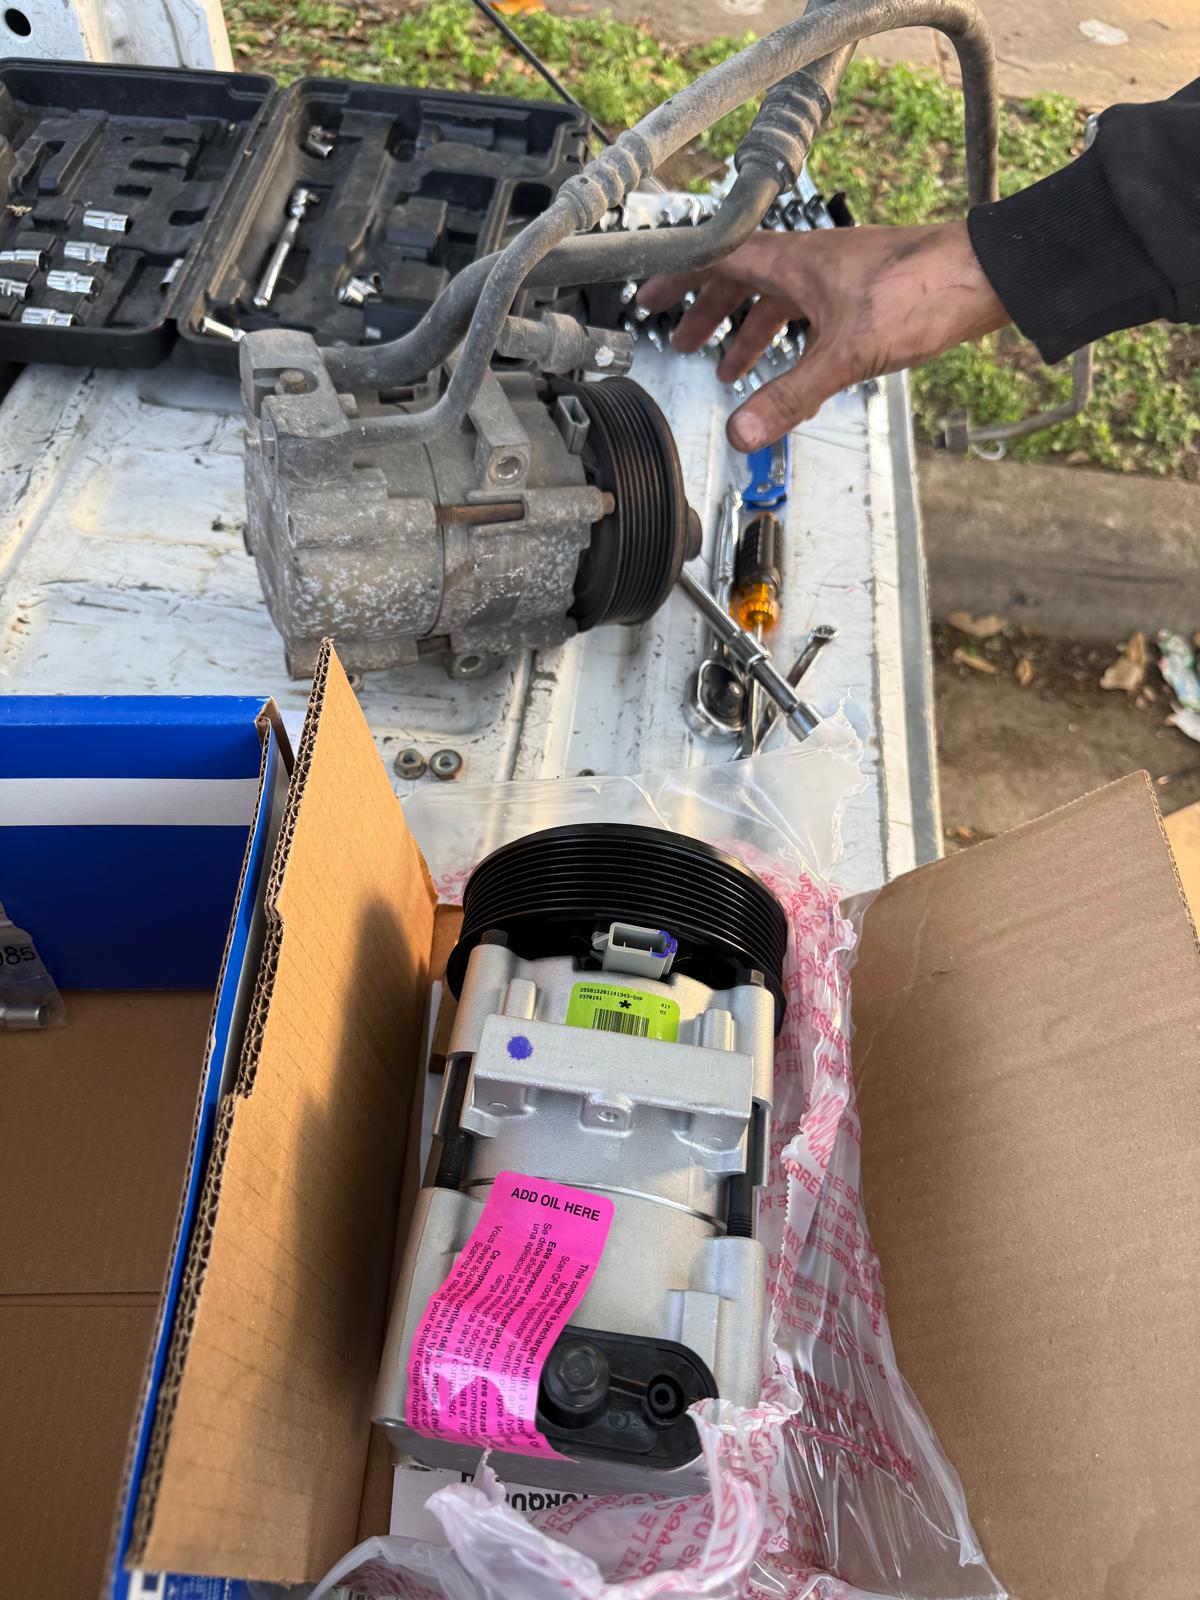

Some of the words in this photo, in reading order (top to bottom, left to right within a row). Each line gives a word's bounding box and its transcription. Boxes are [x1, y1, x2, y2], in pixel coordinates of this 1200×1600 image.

[511, 1187, 538, 1203] ADD
[540, 1194, 561, 1210] OIL
[563, 1201, 601, 1221] HERE
[487, 1226, 502, 1243] Vous
[529, 1223, 539, 1239] una
[542, 1222, 552, 1235] Se
[460, 1241, 482, 1270] Scannez
[475, 1244, 491, 1264] devez
[489, 1249, 500, 1260] Ce
[533, 1237, 546, 1256] debe
[542, 1241, 556, 1259] Este
[512, 1241, 533, 1273] aplicación
[522, 1257, 537, 1276] añadir
[554, 1255, 569, 1272] Scan
[462, 1265, 479, 1288] ajouter
[517, 1276, 526, 1284] la
[522, 1260, 546, 1295] compresor
[548, 1273, 560, 1284] QR
[575, 1265, 588, 1278] This
[489, 1274, 504, 1292] carga
[500, 1274, 515, 1295] puede
[539, 1284, 552, 1300] code
[553, 1282, 567, 1297] Must
[554, 1280, 578, 1315] compressor
[428, 1301, 440, 1321] pour
[443, 1299, 465, 1334] contient
[490, 1310, 503, 1323] tipo
[434, 1320, 443, 1329] et
[476, 1319, 484, 1328] el
[484, 1325, 494, 1336] de
[489, 1307, 516, 1350] precargado
[416, 1323, 431, 1357] obtenir
[431, 1330, 440, 1339] le
[458, 1324, 471, 1344] para
[525, 1321, 552, 1364] precharged
[424, 1341, 436, 1364] type
[454, 1346, 461, 1356] el
[463, 1329, 480, 1359] código
[472, 1337, 487, 1366] aceite
[433, 1361, 441, 1369] 3
[482, 1351, 493, 1372] con
[500, 1340, 516, 1375] specific
[412, 1360, 421, 1385] cette
[460, 1362, 470, 1381] QR
[508, 1353, 523, 1392] amount
[520, 1367, 530, 1389] with
[448, 1358, 459, 1418] compresor.
[460, 1409, 468, 1419] el
[496, 1394, 504, 1417] type
[457, 1422, 467, 1435] tip
